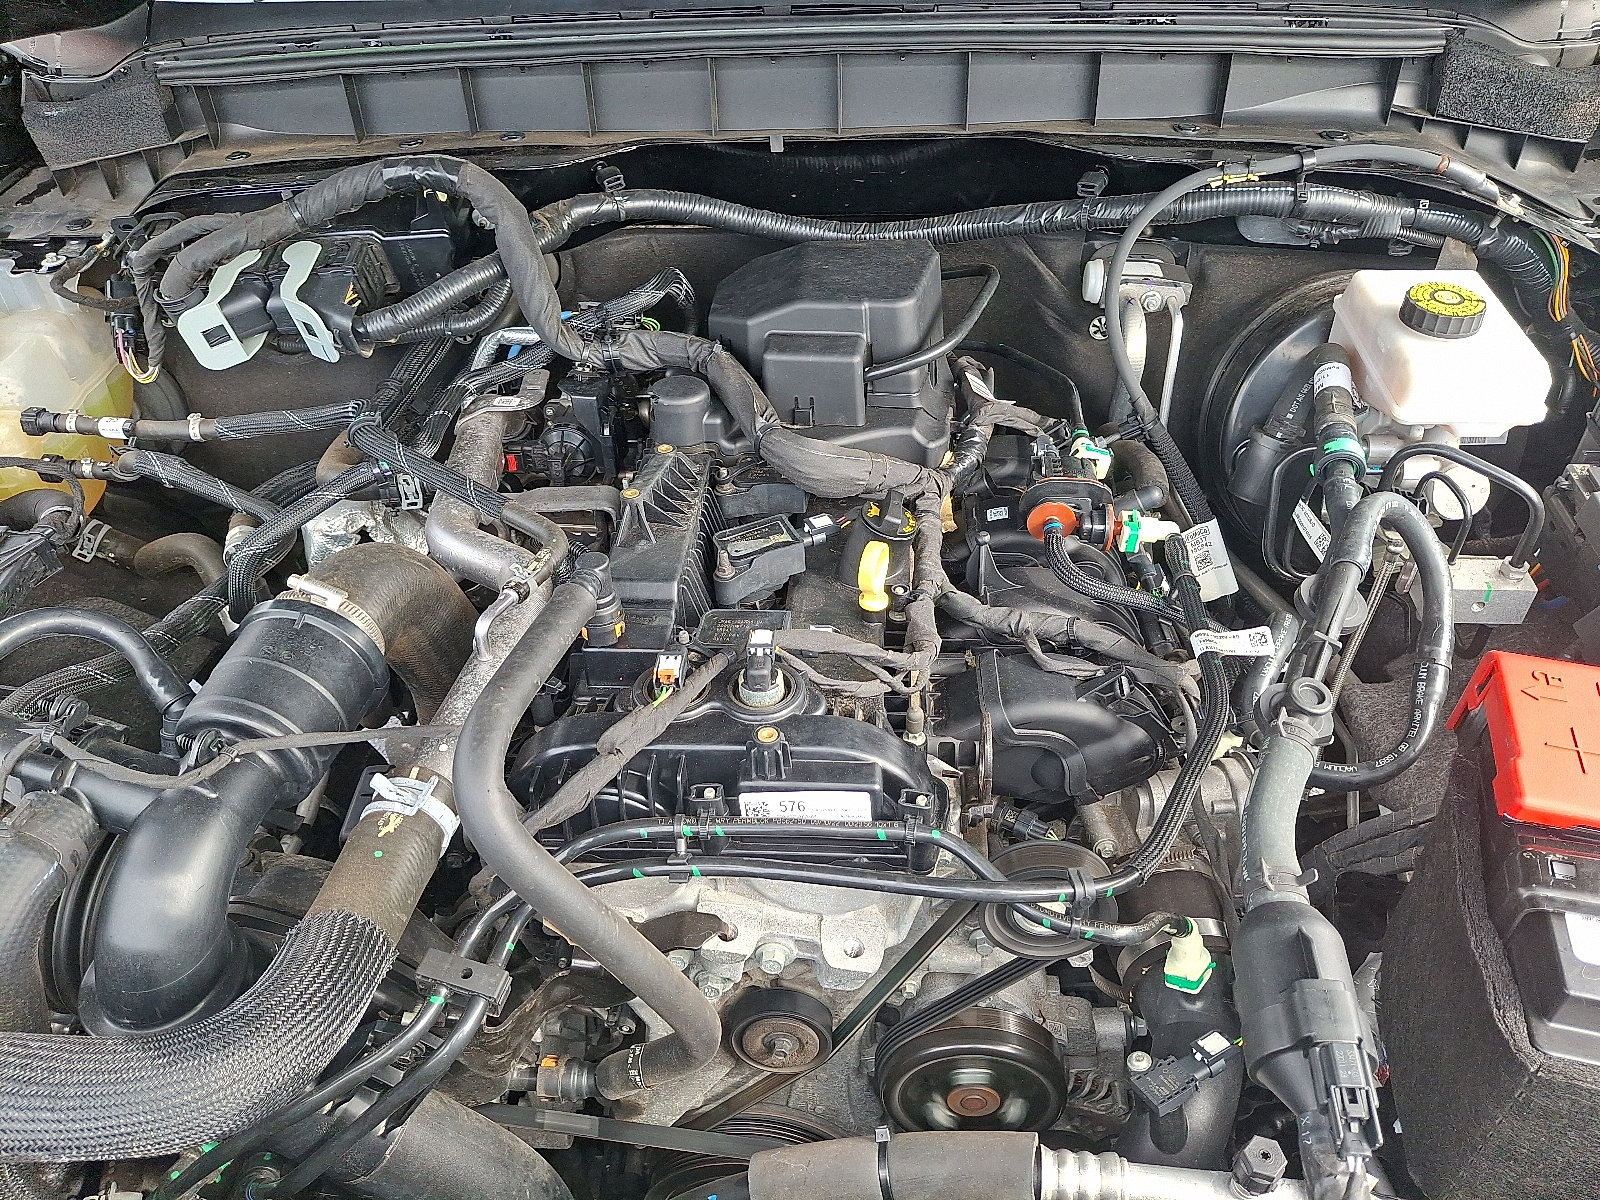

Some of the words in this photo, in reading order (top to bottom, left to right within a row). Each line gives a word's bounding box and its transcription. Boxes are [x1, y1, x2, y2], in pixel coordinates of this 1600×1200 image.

[1415, 682, 1426, 706] BRAKE
[1406, 708, 1422, 739] ARNITEL
[1323, 763, 1358, 773] VACUUM
[779, 800, 806, 813] 576
